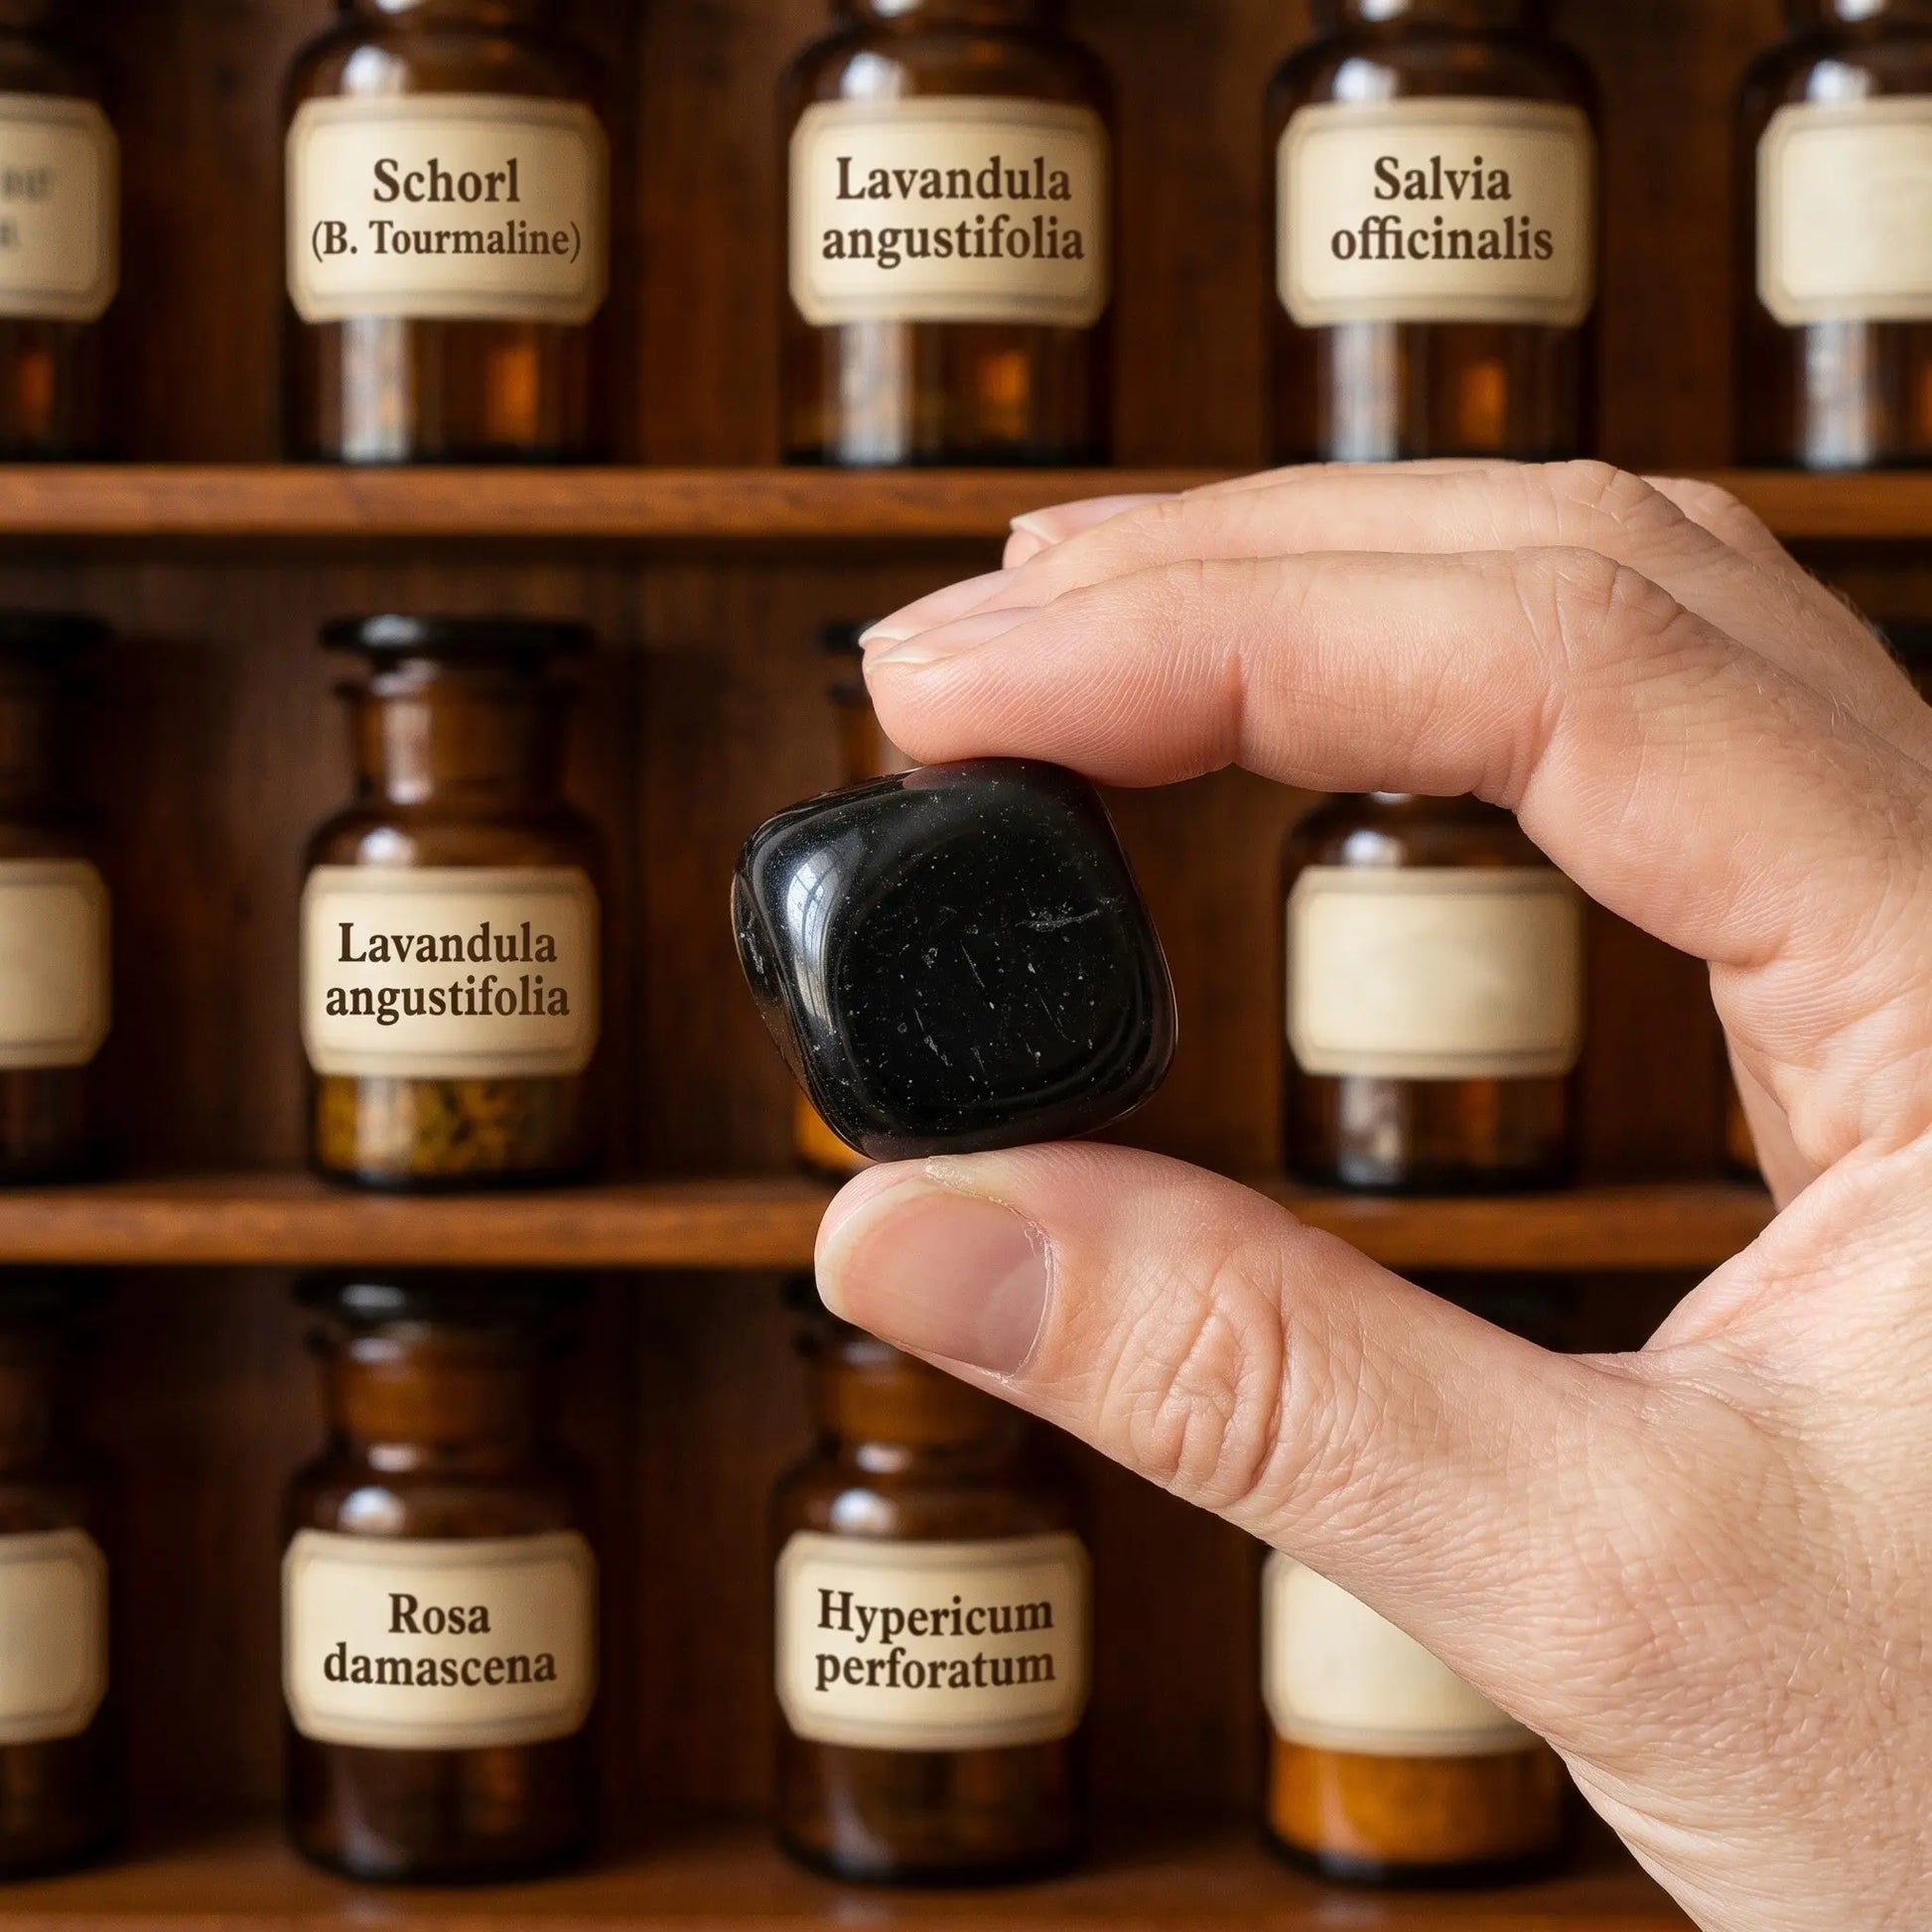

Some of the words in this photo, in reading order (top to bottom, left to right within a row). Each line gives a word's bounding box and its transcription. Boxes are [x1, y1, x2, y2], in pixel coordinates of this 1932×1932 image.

[373, 158, 520, 203] Schorl
[836, 155, 1072, 201] Lavandula
[1374, 155, 1512, 201] Salvia
[312, 220, 357, 263] (B.
[368, 219, 581, 263] Tourmaline)
[822, 213, 1085, 270] angustifolia
[1331, 215, 1554, 260] officinalis
[338, 921, 558, 963] Lavandula
[326, 974, 571, 1027] angustifolia
[388, 1592, 491, 1635] Rosa
[817, 1587, 1054, 1644] Hypericum
[324, 1641, 557, 1687] damascena
[815, 1646, 1056, 1693] perforatum
